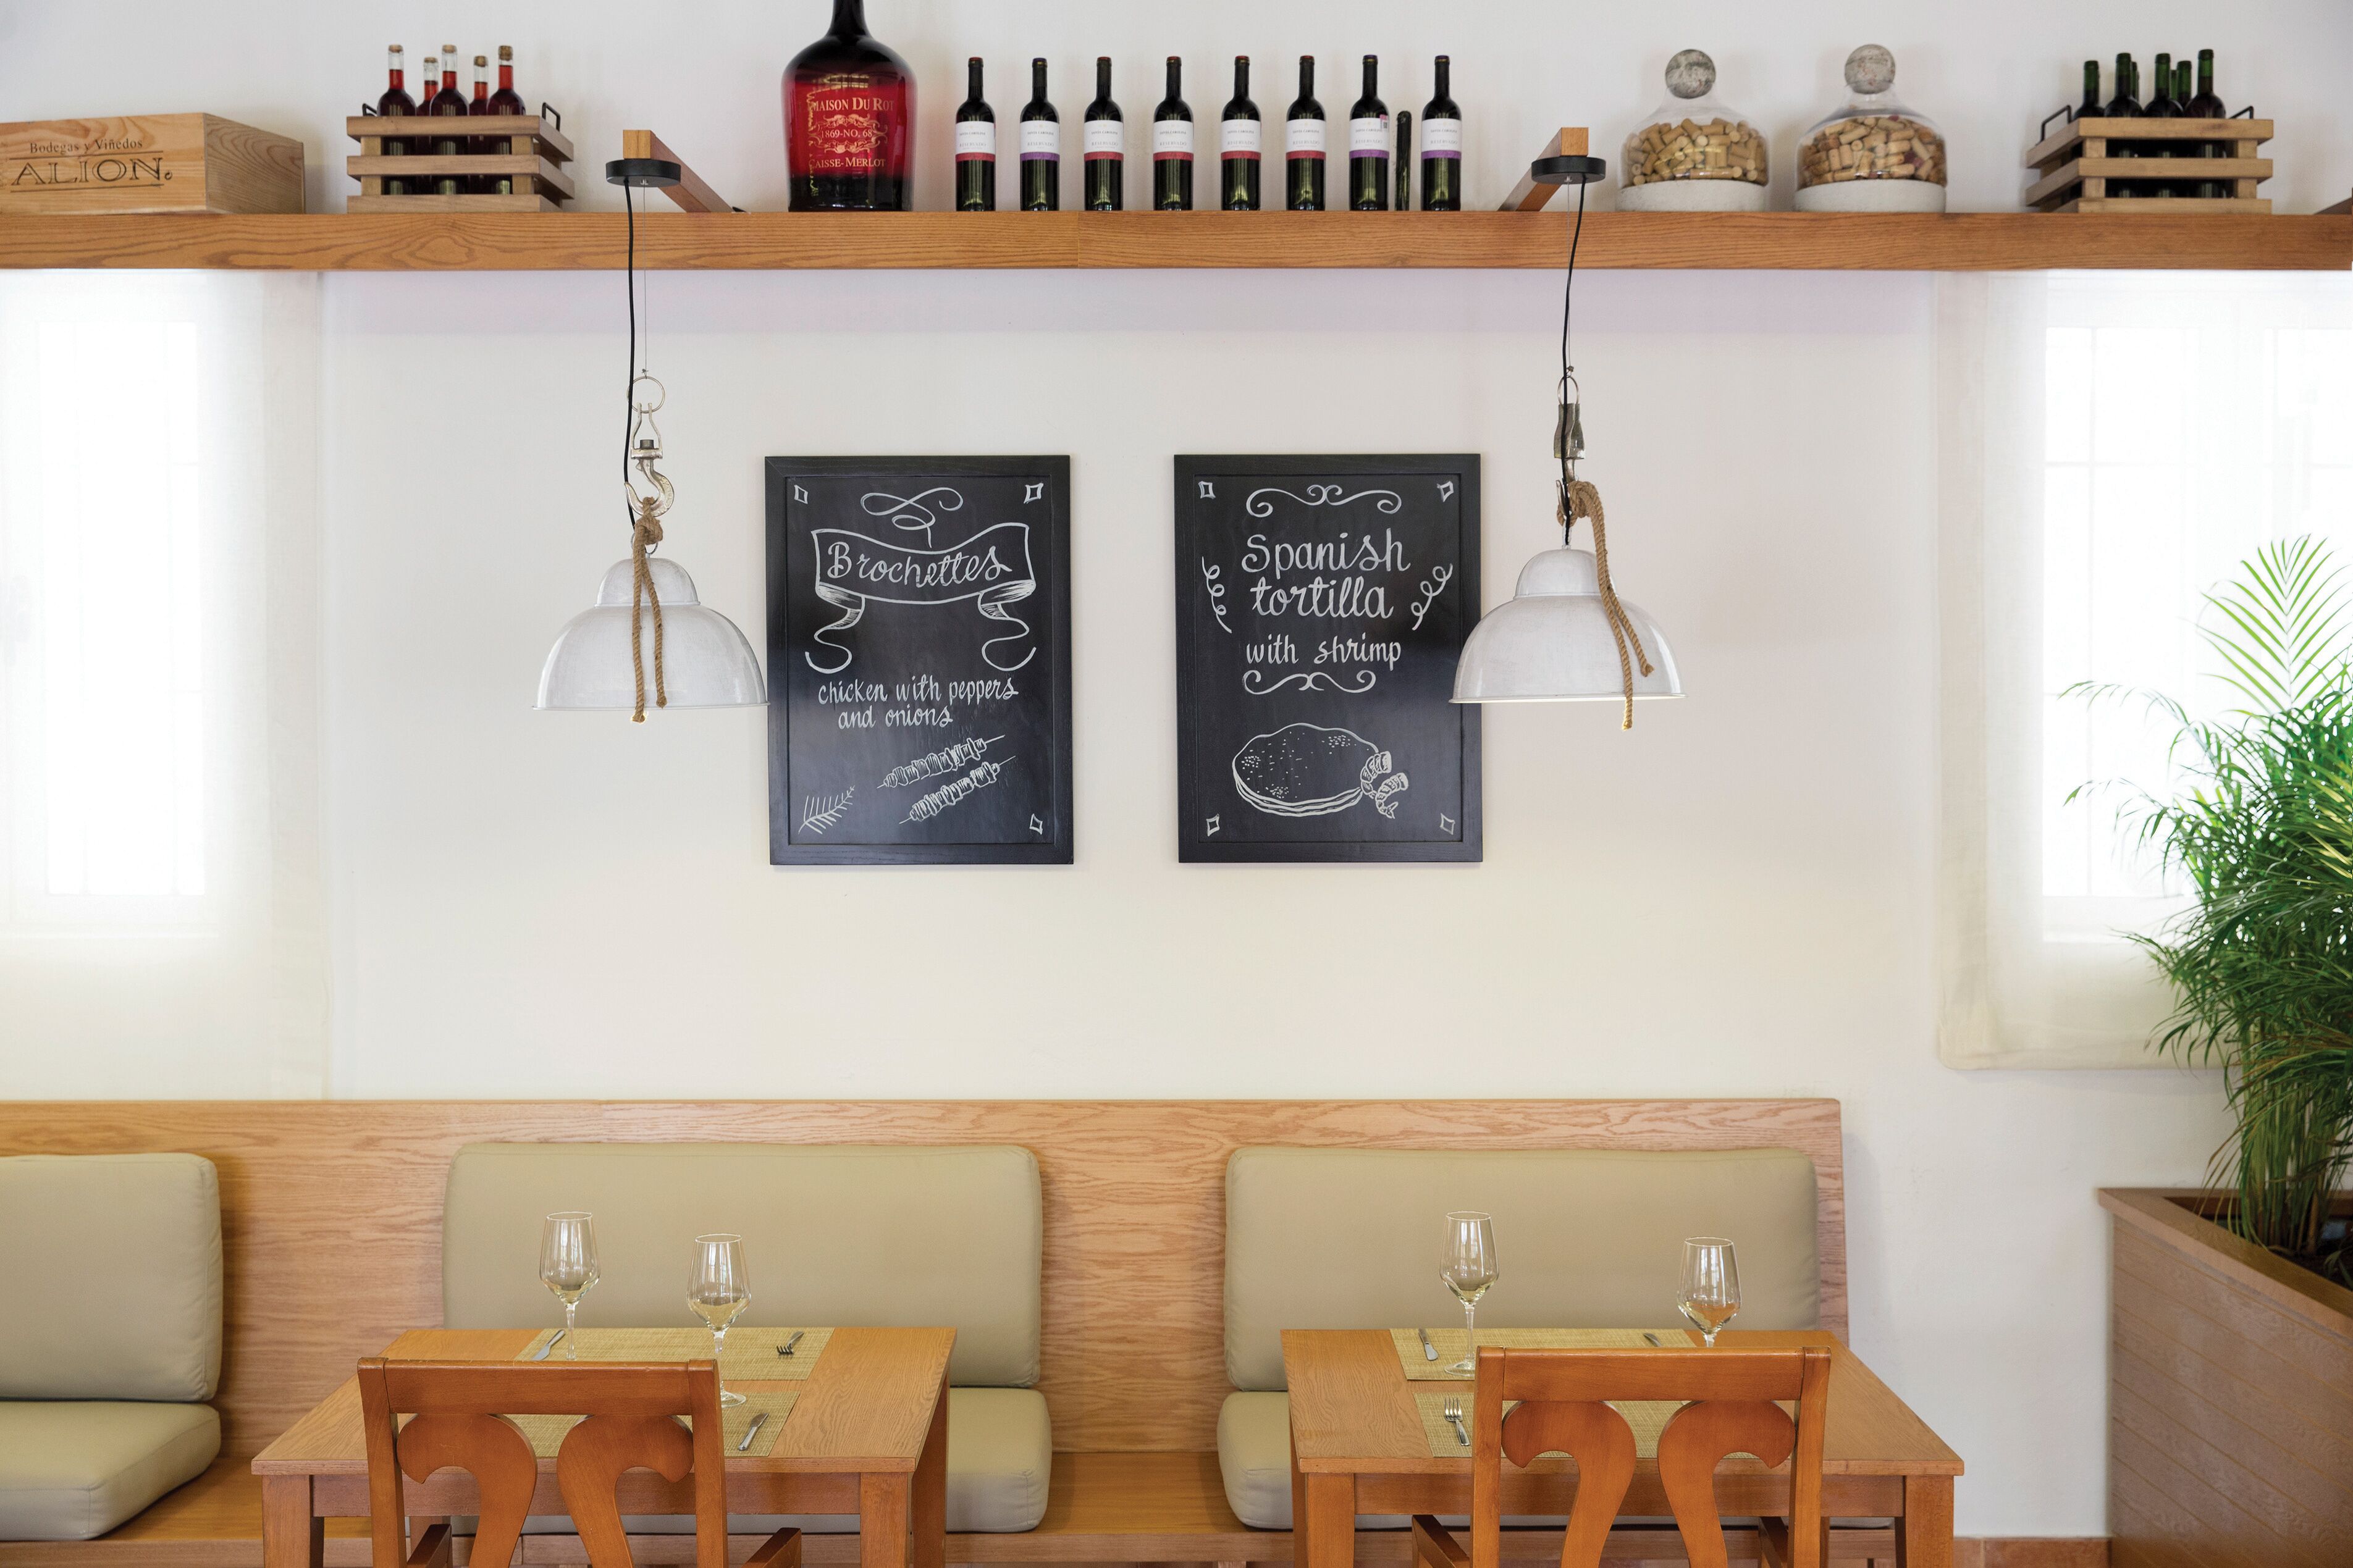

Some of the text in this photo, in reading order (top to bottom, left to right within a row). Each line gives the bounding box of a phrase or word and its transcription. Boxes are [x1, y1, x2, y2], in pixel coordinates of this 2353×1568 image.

[811, 99, 849, 111] MAISON
[30, 138, 143, 154] Bodegas y Viñedos
[862, 129, 872, 138] 68
[827, 542, 1012, 588] Brochettes
[1242, 527, 1411, 579] Spanish
[1250, 576, 1394, 618] tortilla
[1246, 632, 1402, 671] with shrimp
[818, 674, 1019, 705] chicken with peppers
[838, 704, 953, 729] and onions
